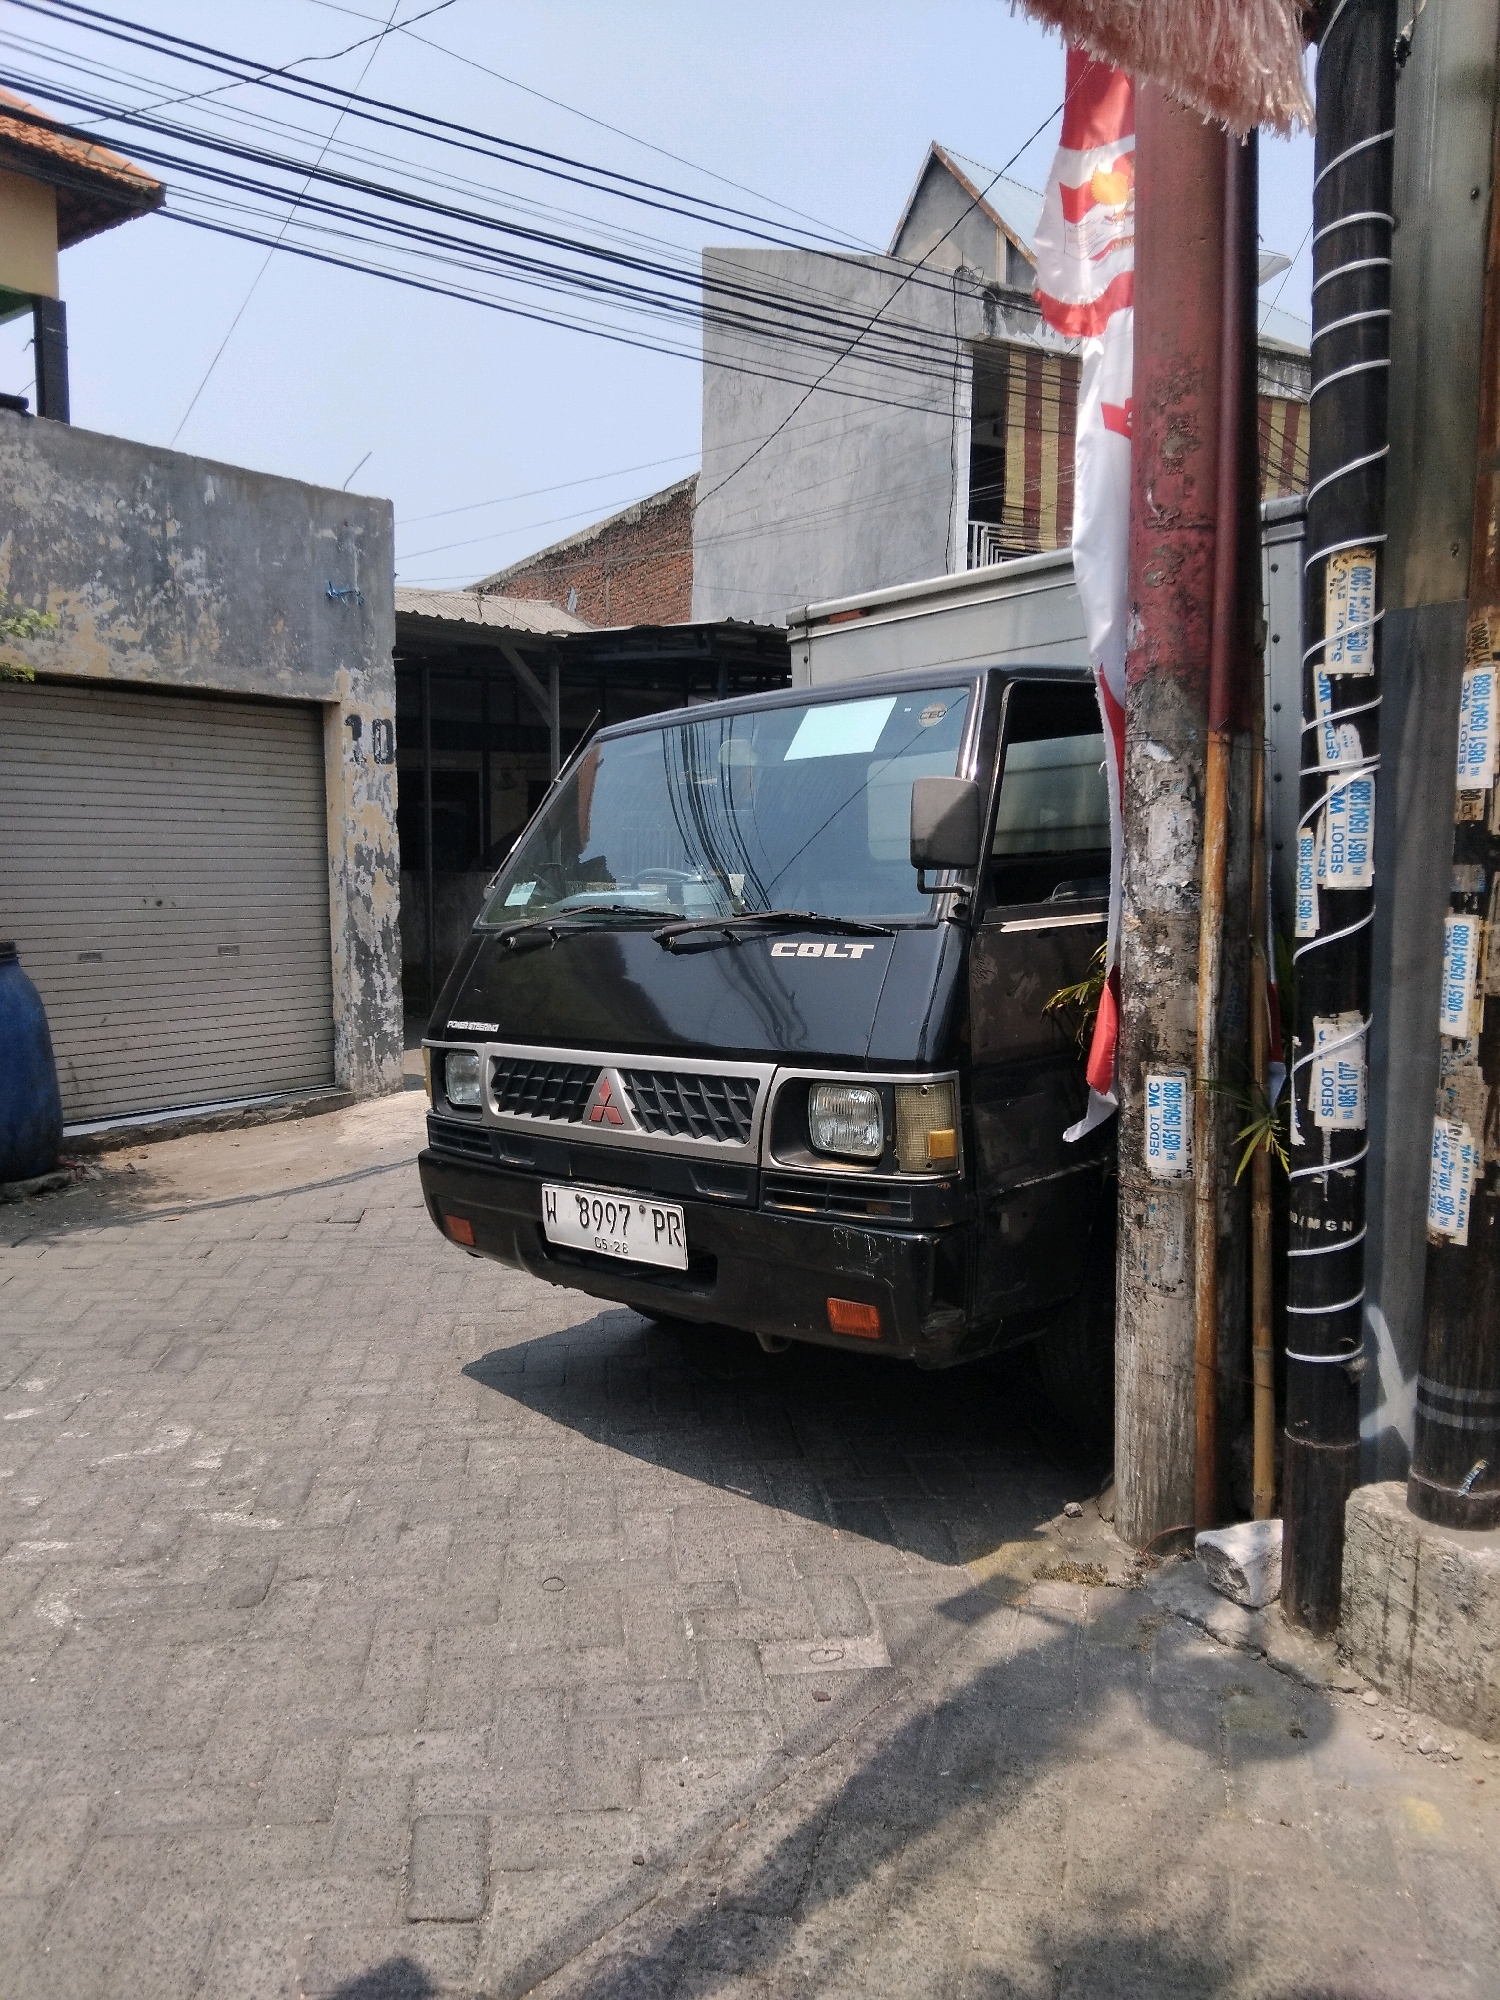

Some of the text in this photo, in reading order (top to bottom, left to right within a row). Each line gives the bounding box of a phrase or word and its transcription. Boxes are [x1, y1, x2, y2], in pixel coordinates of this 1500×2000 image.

[344, 714, 394, 765] 10
[1458, 679, 1472, 775] SEDOT WC
[1468, 673, 1492, 778] WA 0851 05041888
[1330, 823, 1345, 874] SEDOT
[1348, 780, 1373, 876] WA 0851 05041888
[1299, 838, 1313, 931] WA 0851 05041888
[770, 942, 875, 959] COLT
[1447, 924, 1471, 1023] WA 0851 05041888
[447, 1020, 500, 1032] POWER STEERING
[1162, 1081, 1183, 1126] 05041888
[1321, 1067, 1335, 1118] SEDOT
[1337, 1083, 1359, 1108] 0851
[1342, 1109, 1355, 1120] WA
[1148, 1082, 1161, 1157] SEDOT WC
[1162, 1128, 1182, 1151] 0851
[1166, 1152, 1177, 1161] WA
[545, 1190, 683, 1247] W 8997 PR
[1438, 1215, 1450, 1227] WA
